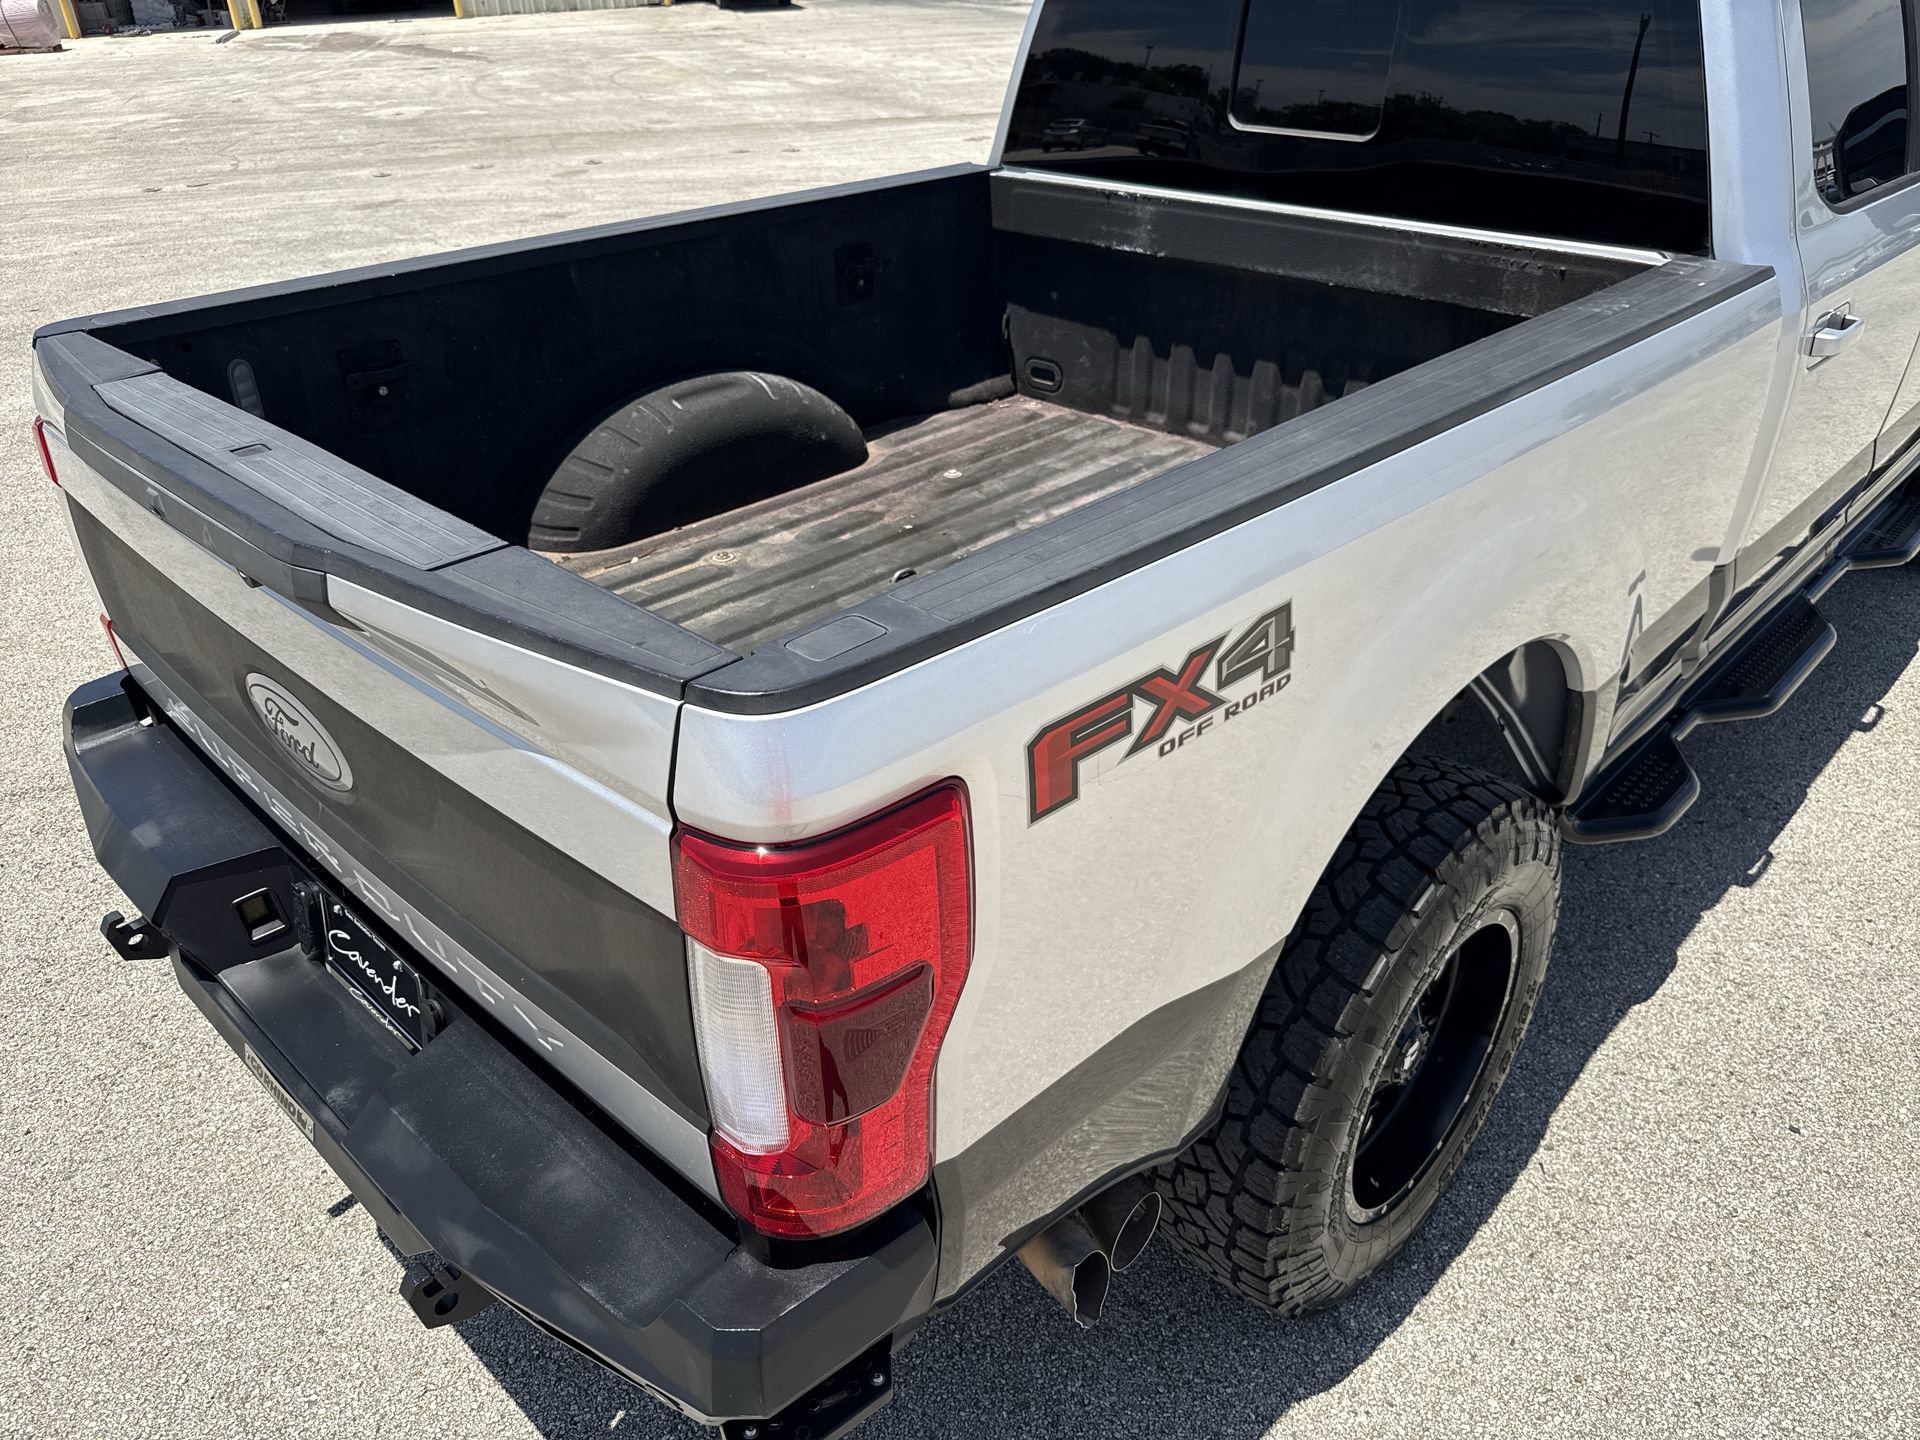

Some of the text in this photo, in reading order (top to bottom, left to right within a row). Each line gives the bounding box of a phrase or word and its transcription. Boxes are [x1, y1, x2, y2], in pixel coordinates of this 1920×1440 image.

[264, 697, 320, 769] Ford
[1024, 598, 1296, 829] FX4
[1158, 673, 1292, 758] OFF ROAD
[167, 697, 565, 1052] SUPER DUTY
[328, 929, 421, 1018] Cavender
[349, 987, 403, 1038] Cavender
